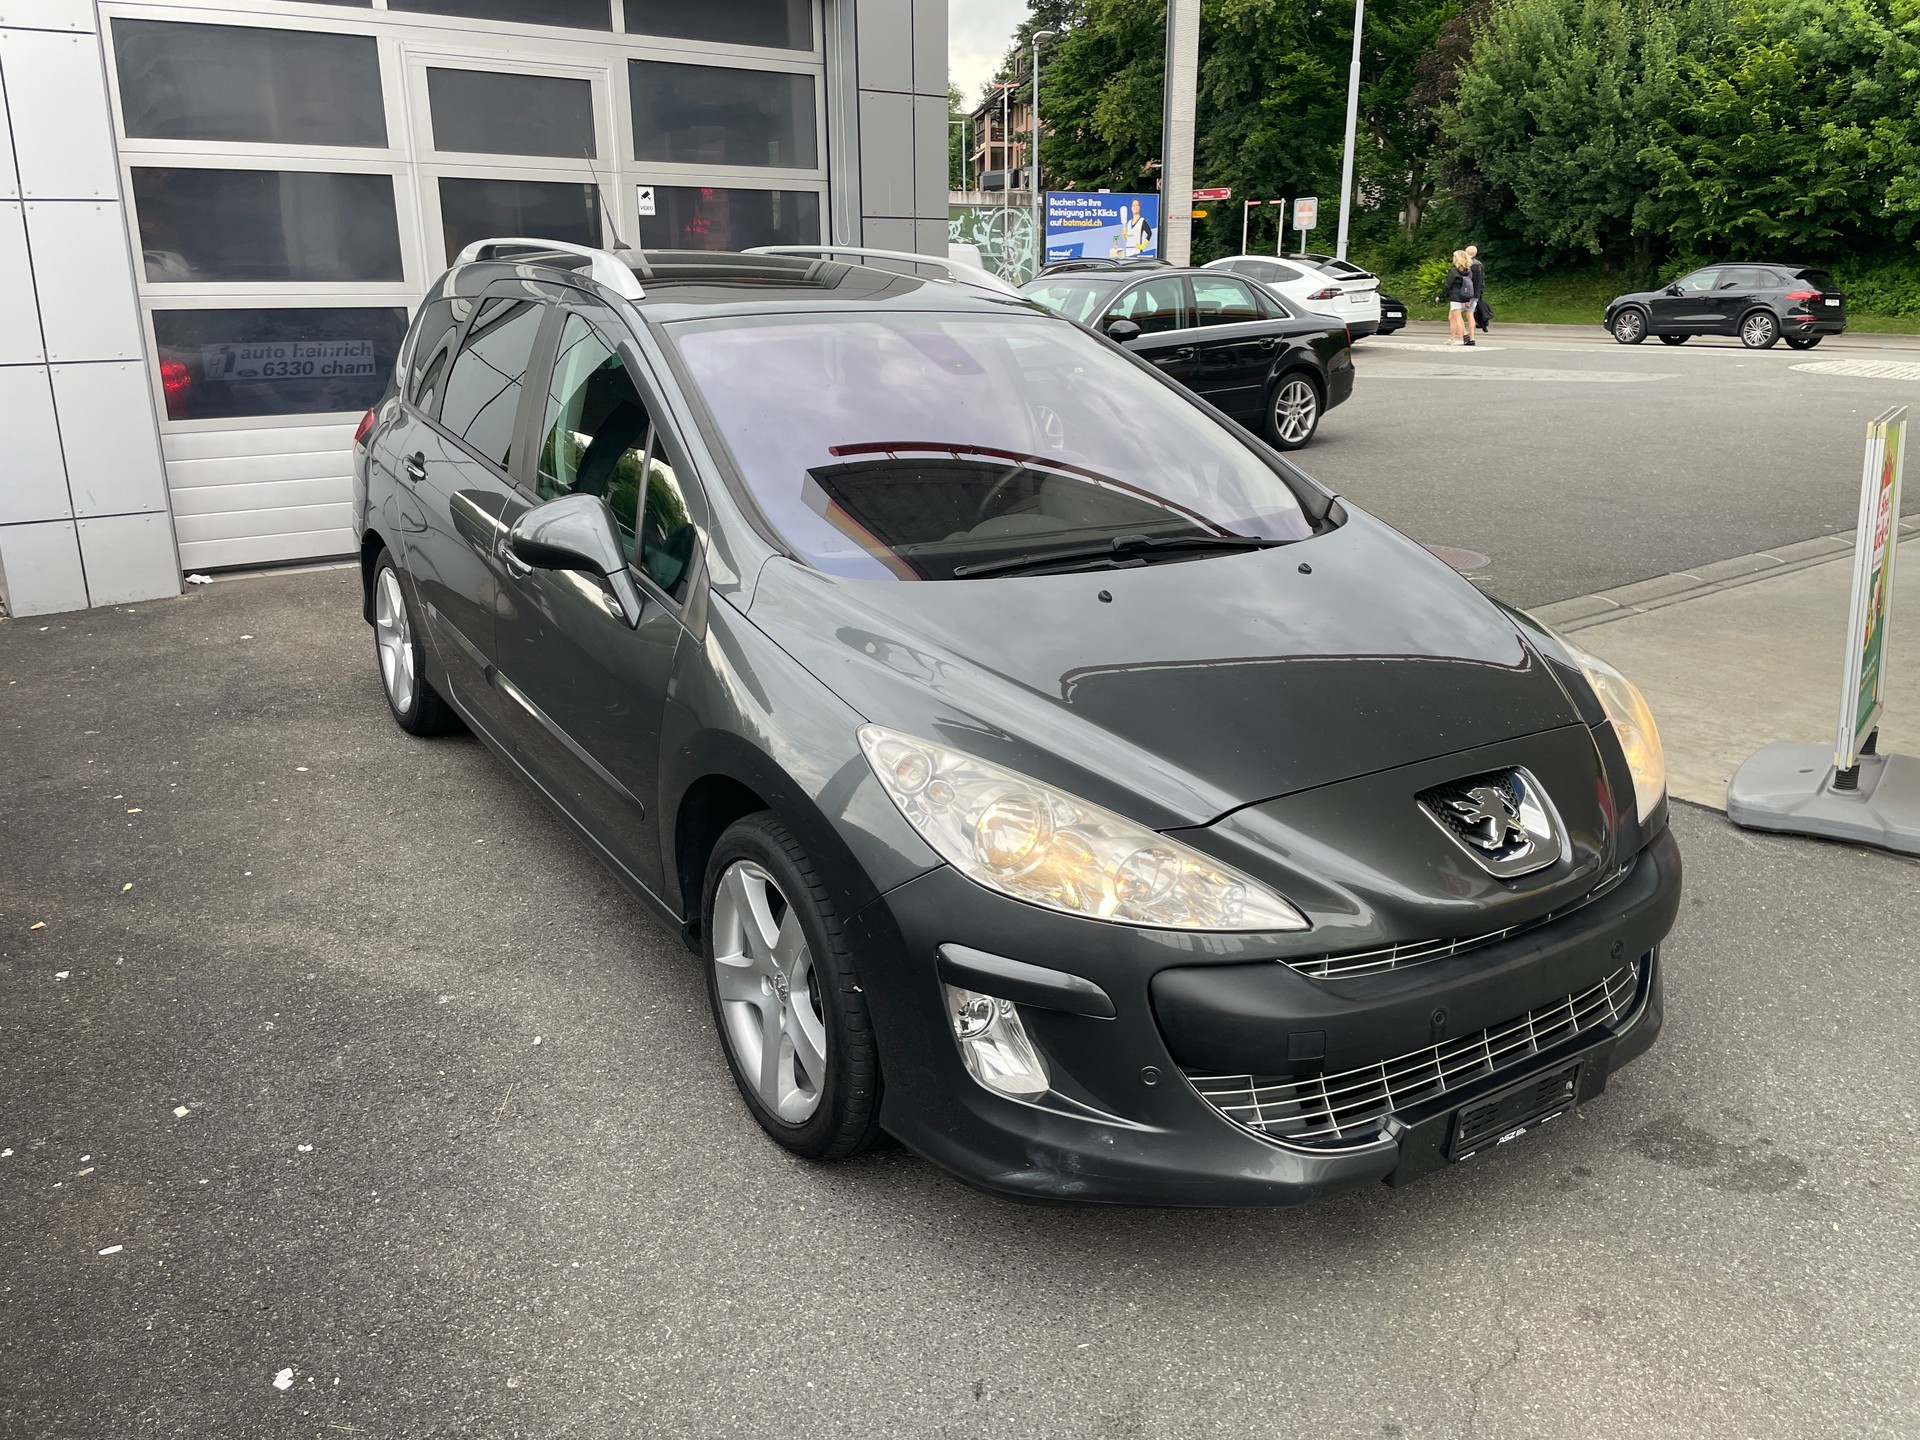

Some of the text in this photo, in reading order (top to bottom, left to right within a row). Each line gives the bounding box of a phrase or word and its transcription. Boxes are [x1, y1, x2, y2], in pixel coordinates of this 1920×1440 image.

[1049, 197, 1102, 207] Buchen Sie Ihre
[1049, 207, 1118, 218] Reinigung in 3 Klicks
[1049, 218, 1062, 226] auf
[240, 342, 372, 360] auto heinrich
[262, 361, 315, 377] 6330
[320, 360, 374, 375] cham
